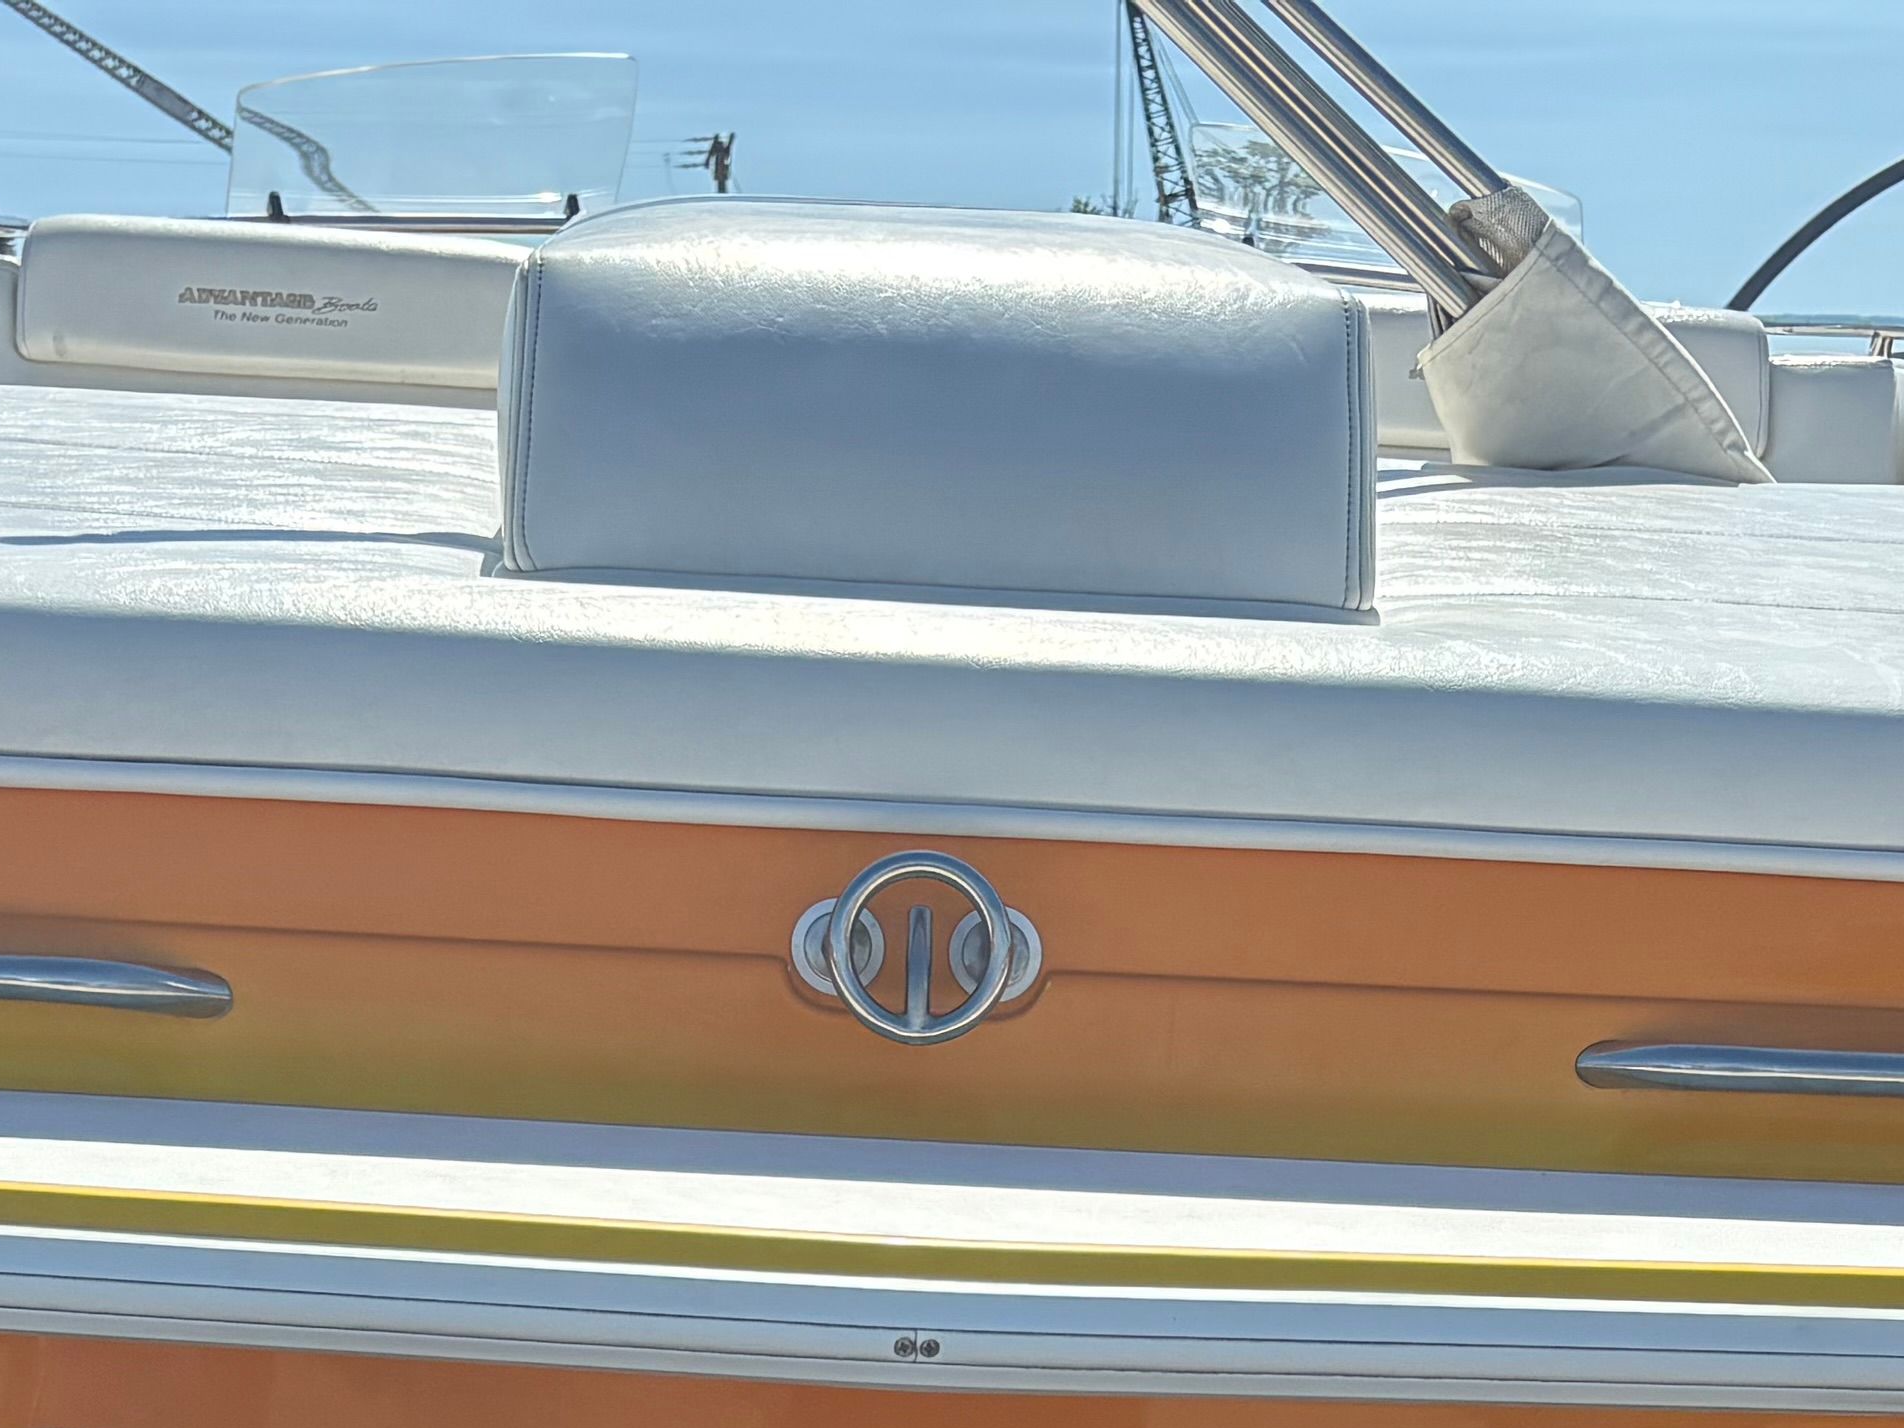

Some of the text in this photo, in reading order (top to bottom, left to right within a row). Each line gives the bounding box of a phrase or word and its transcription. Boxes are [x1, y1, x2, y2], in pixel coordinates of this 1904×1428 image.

[213, 309, 349, 328] The New Generation
